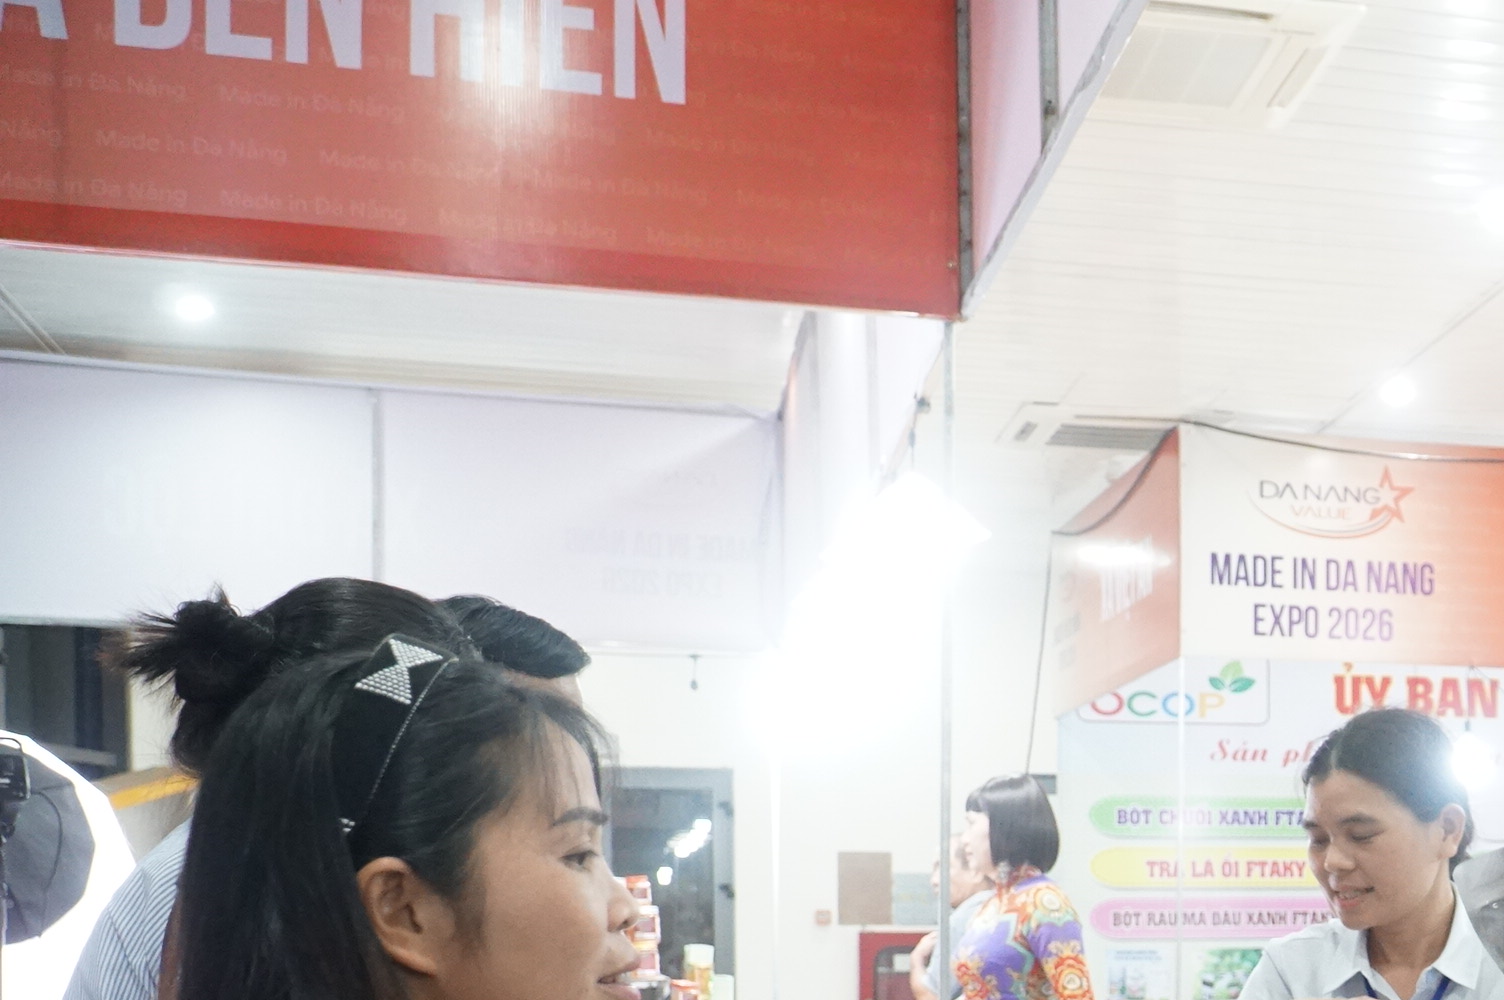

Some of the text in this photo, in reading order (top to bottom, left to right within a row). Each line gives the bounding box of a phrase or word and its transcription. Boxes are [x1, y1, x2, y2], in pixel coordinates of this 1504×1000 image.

[1259, 479, 1382, 505] DA NANG
[1290, 504, 1353, 520] VALUE
[1210, 551, 1435, 597] MADE IN DA NANG
[1253, 603, 1394, 642] EXPO 2026
[1333, 661, 1392, 715] ỦY
[1406, 676, 1499, 718] BAN
[1091, 691, 1225, 717] OCOP
[1219, 809, 1268, 826] XANH
[1246, 860, 1306, 878] FTAKY
[1247, 911, 1288, 926] XANH
